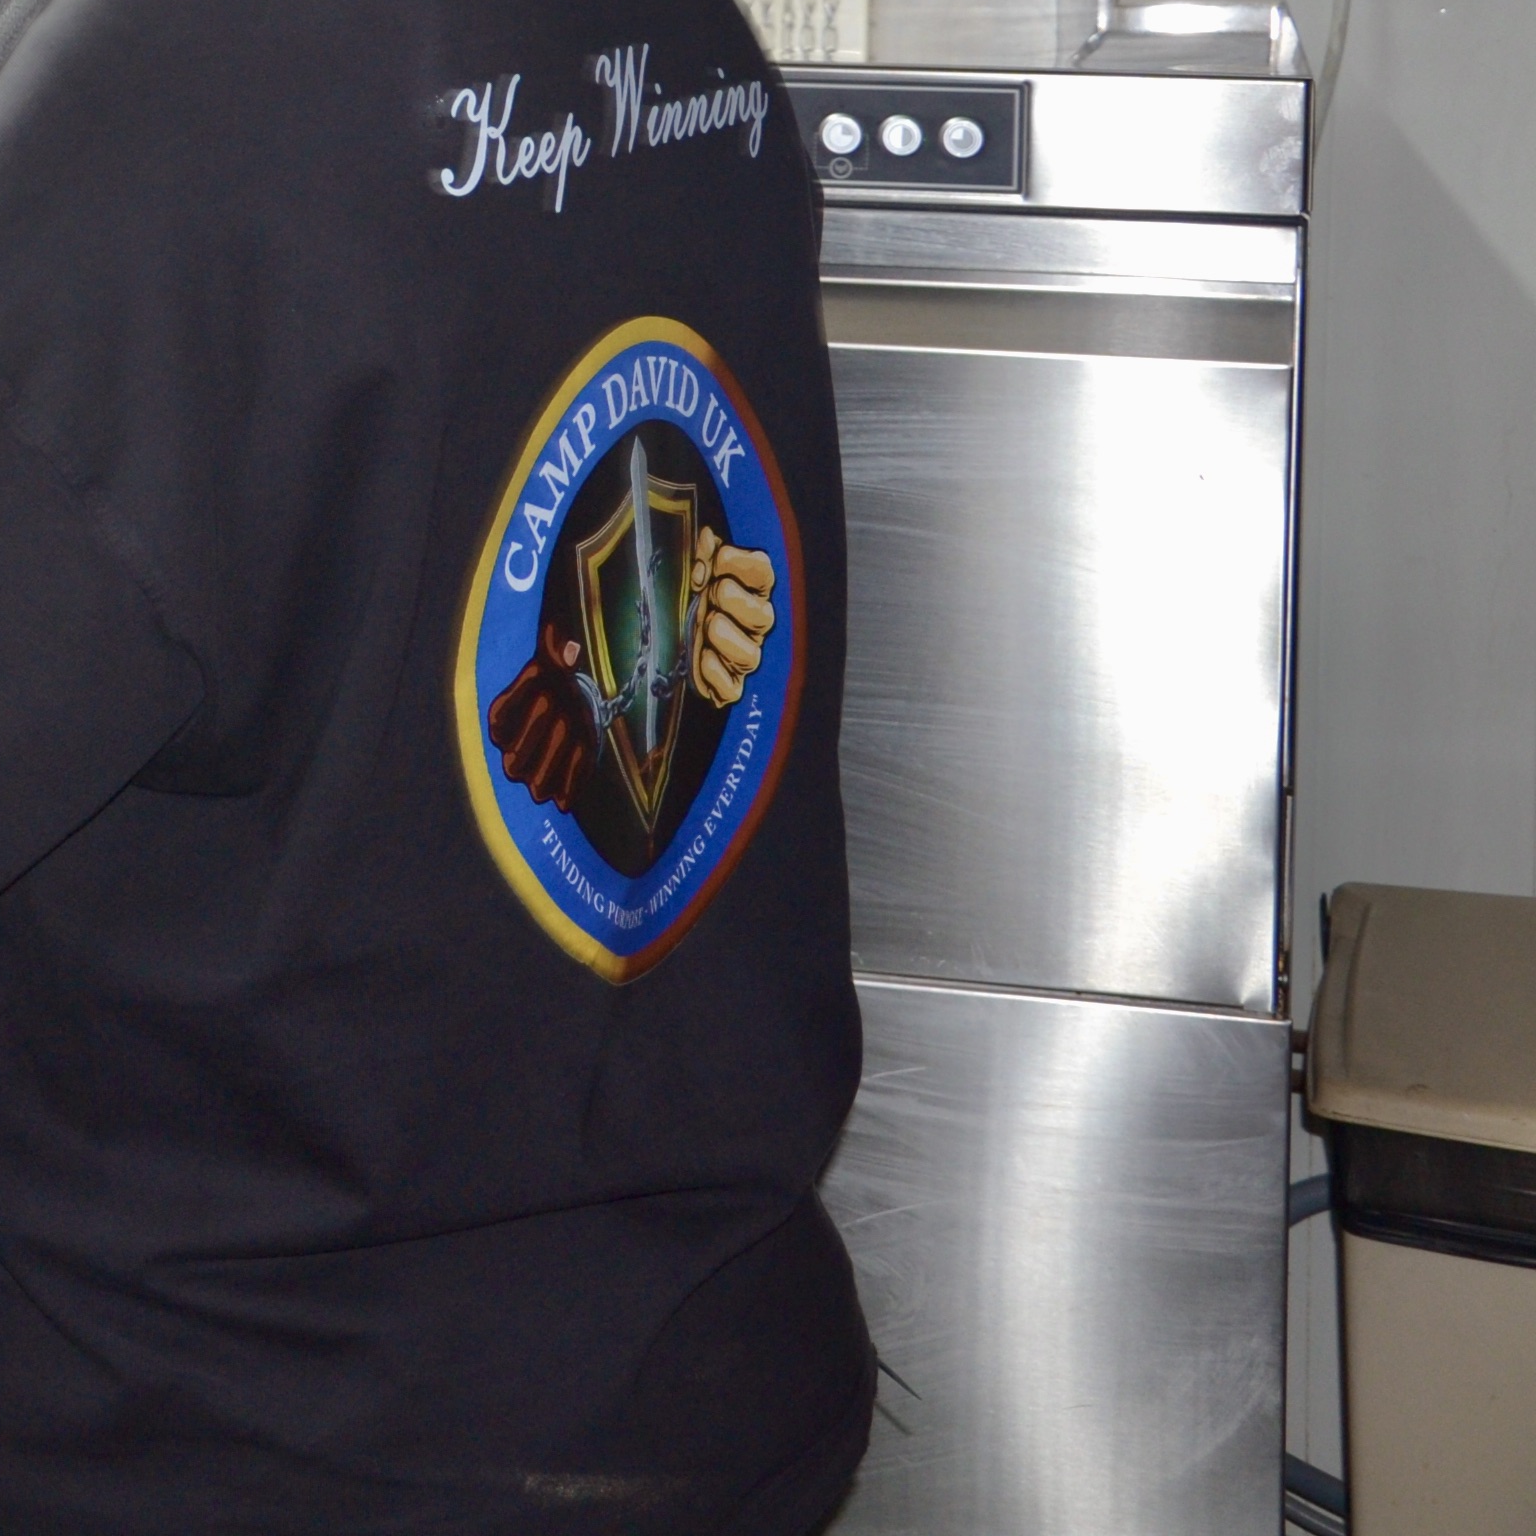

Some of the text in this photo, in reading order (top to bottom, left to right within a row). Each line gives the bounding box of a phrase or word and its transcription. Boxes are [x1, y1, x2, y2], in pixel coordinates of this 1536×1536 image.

[441, 43, 768, 213] Keep Winning
[504, 356, 746, 592] CAMP DAVID UK
